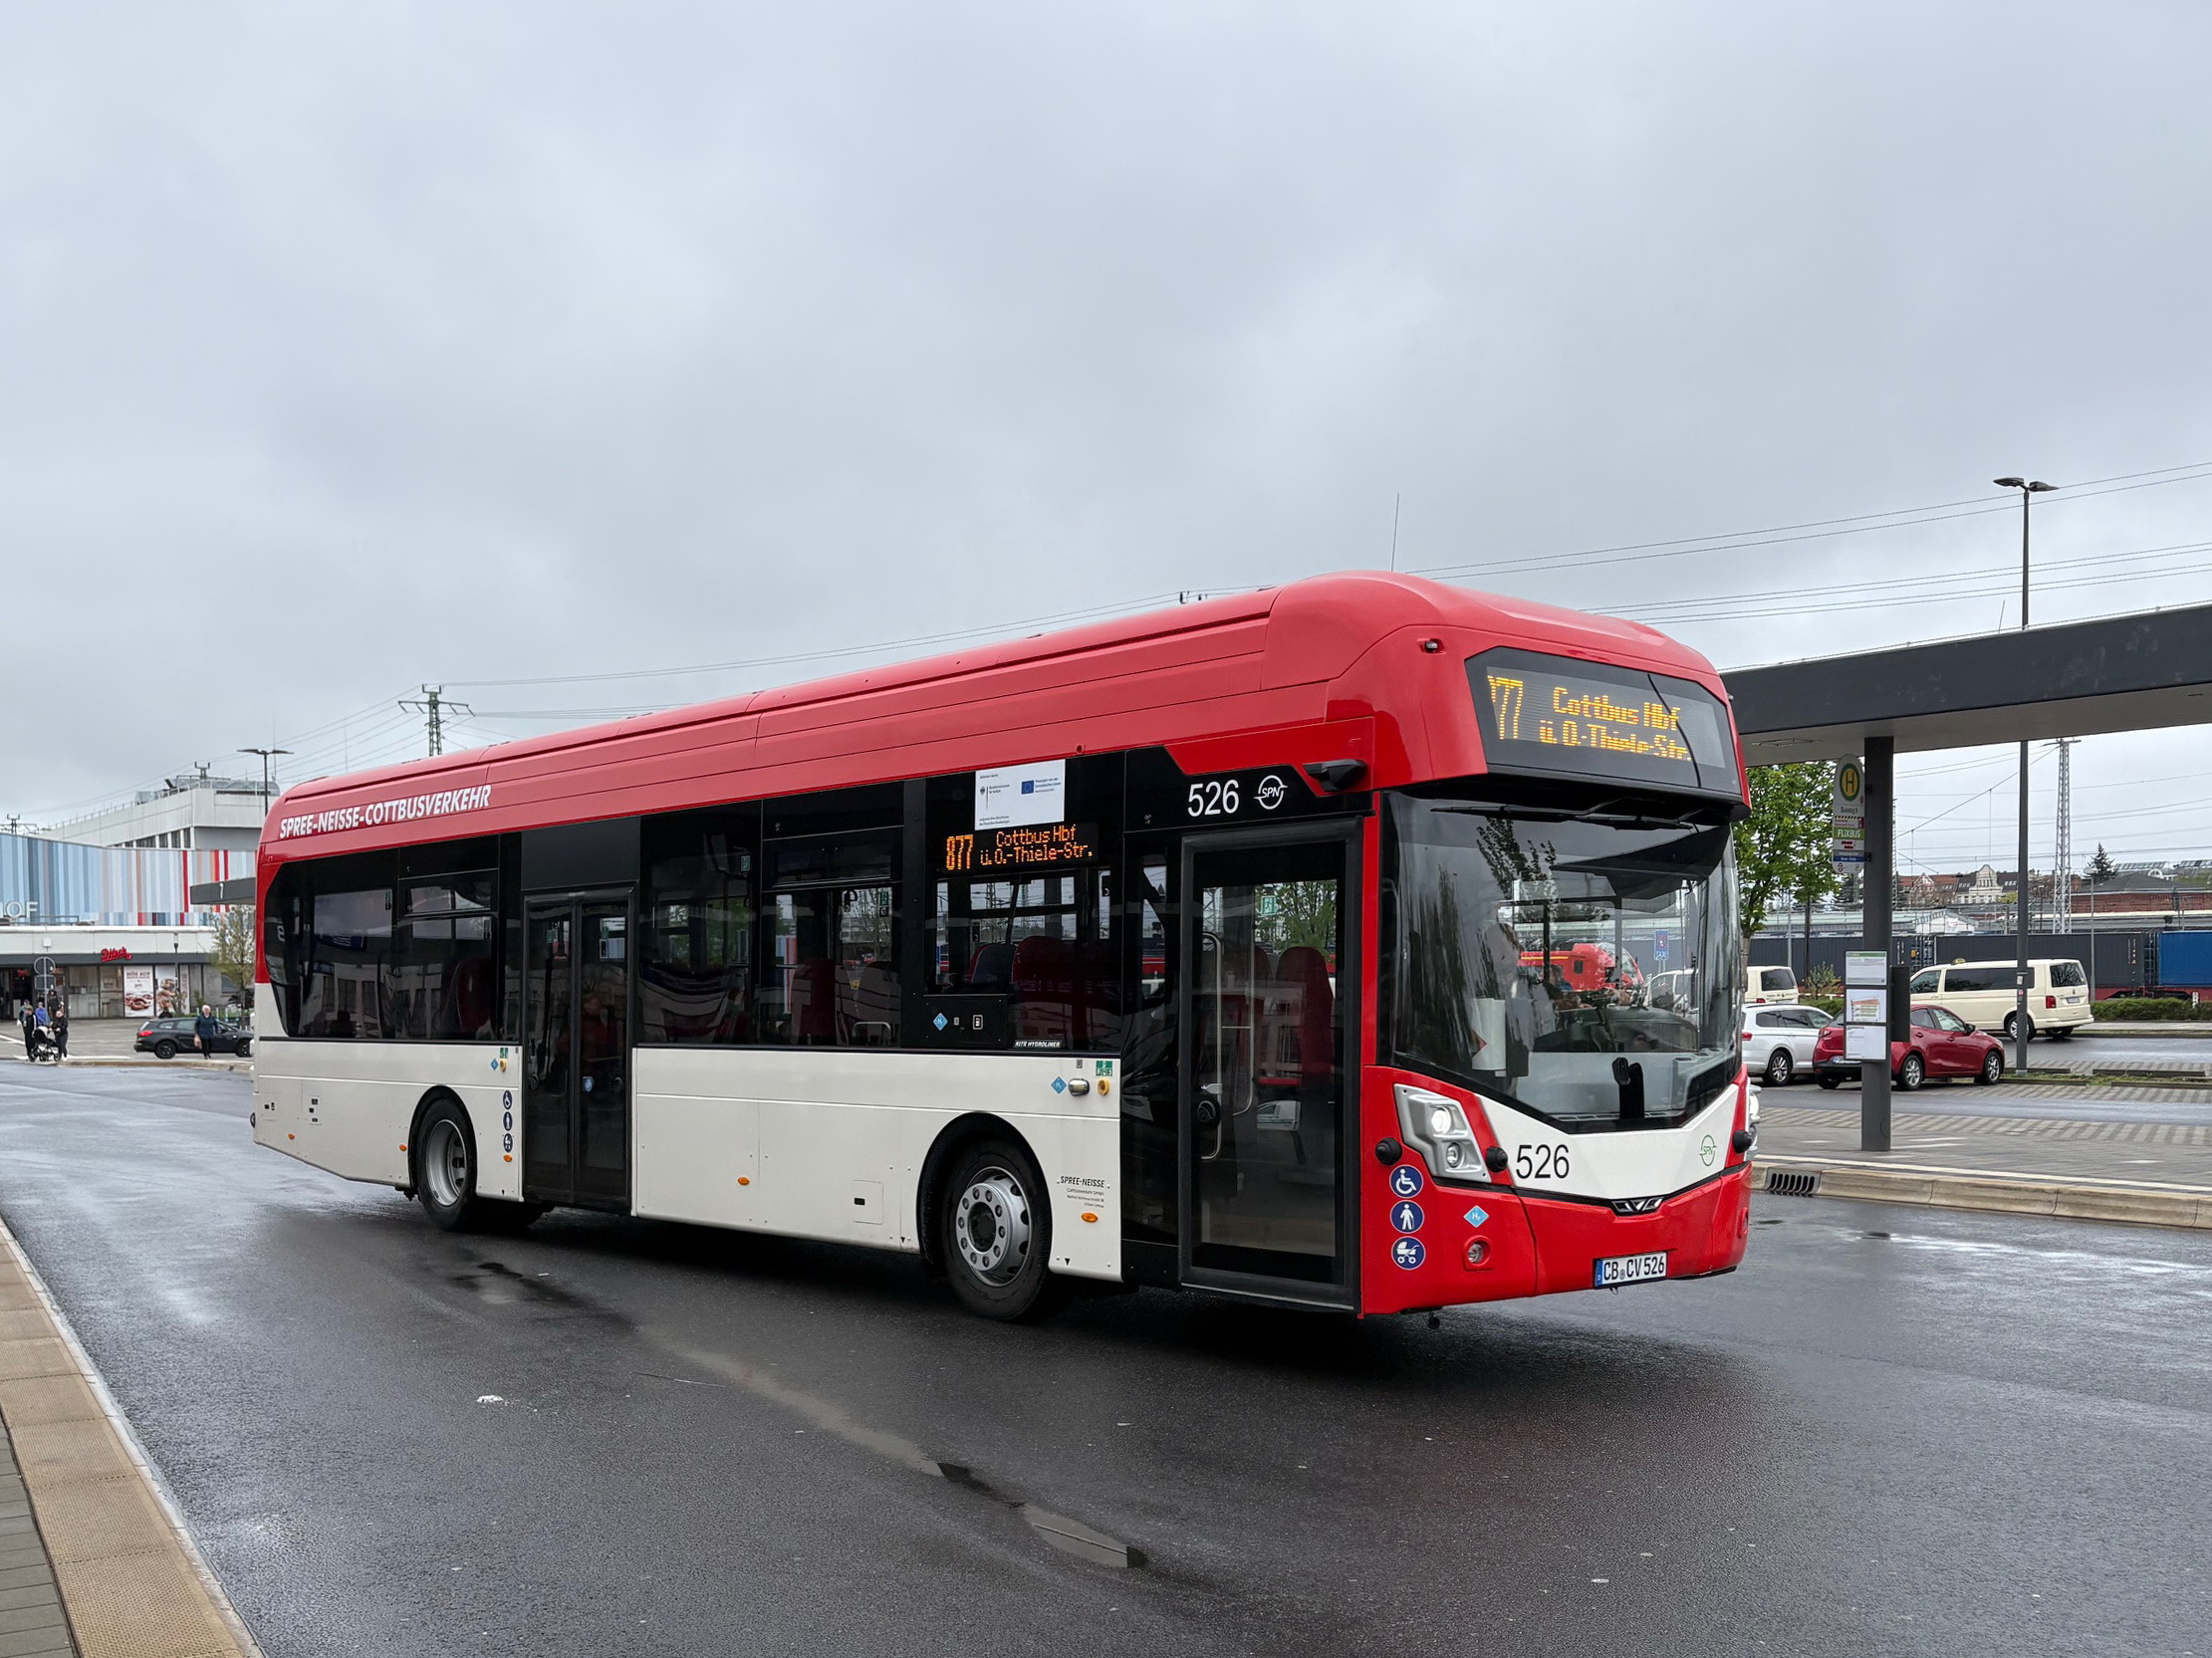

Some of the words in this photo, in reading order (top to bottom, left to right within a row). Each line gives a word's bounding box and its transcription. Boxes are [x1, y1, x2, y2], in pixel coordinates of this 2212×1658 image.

[1553, 686, 1639, 725] Cottbus
[1643, 701, 1681, 731] Hbf
[1845, 771, 1855, 794] H
[279, 784, 492, 838] SPREE-NEISSE-COTTBUSVERKEHR
[1187, 779, 1240, 817] 526
[996, 829, 1051, 846] Cottbus
[1053, 824, 1077, 842] Hbf
[946, 834, 974, 870] 877
[0, 900, 39, 918] OF
[1515, 1144, 1570, 1179] 526
[1061, 1176, 1106, 1188] SPREE-NEISSE
[1603, 1261, 1618, 1281] CB
[1626, 1258, 1642, 1278] CV
[1643, 1256, 1665, 1276] 526
